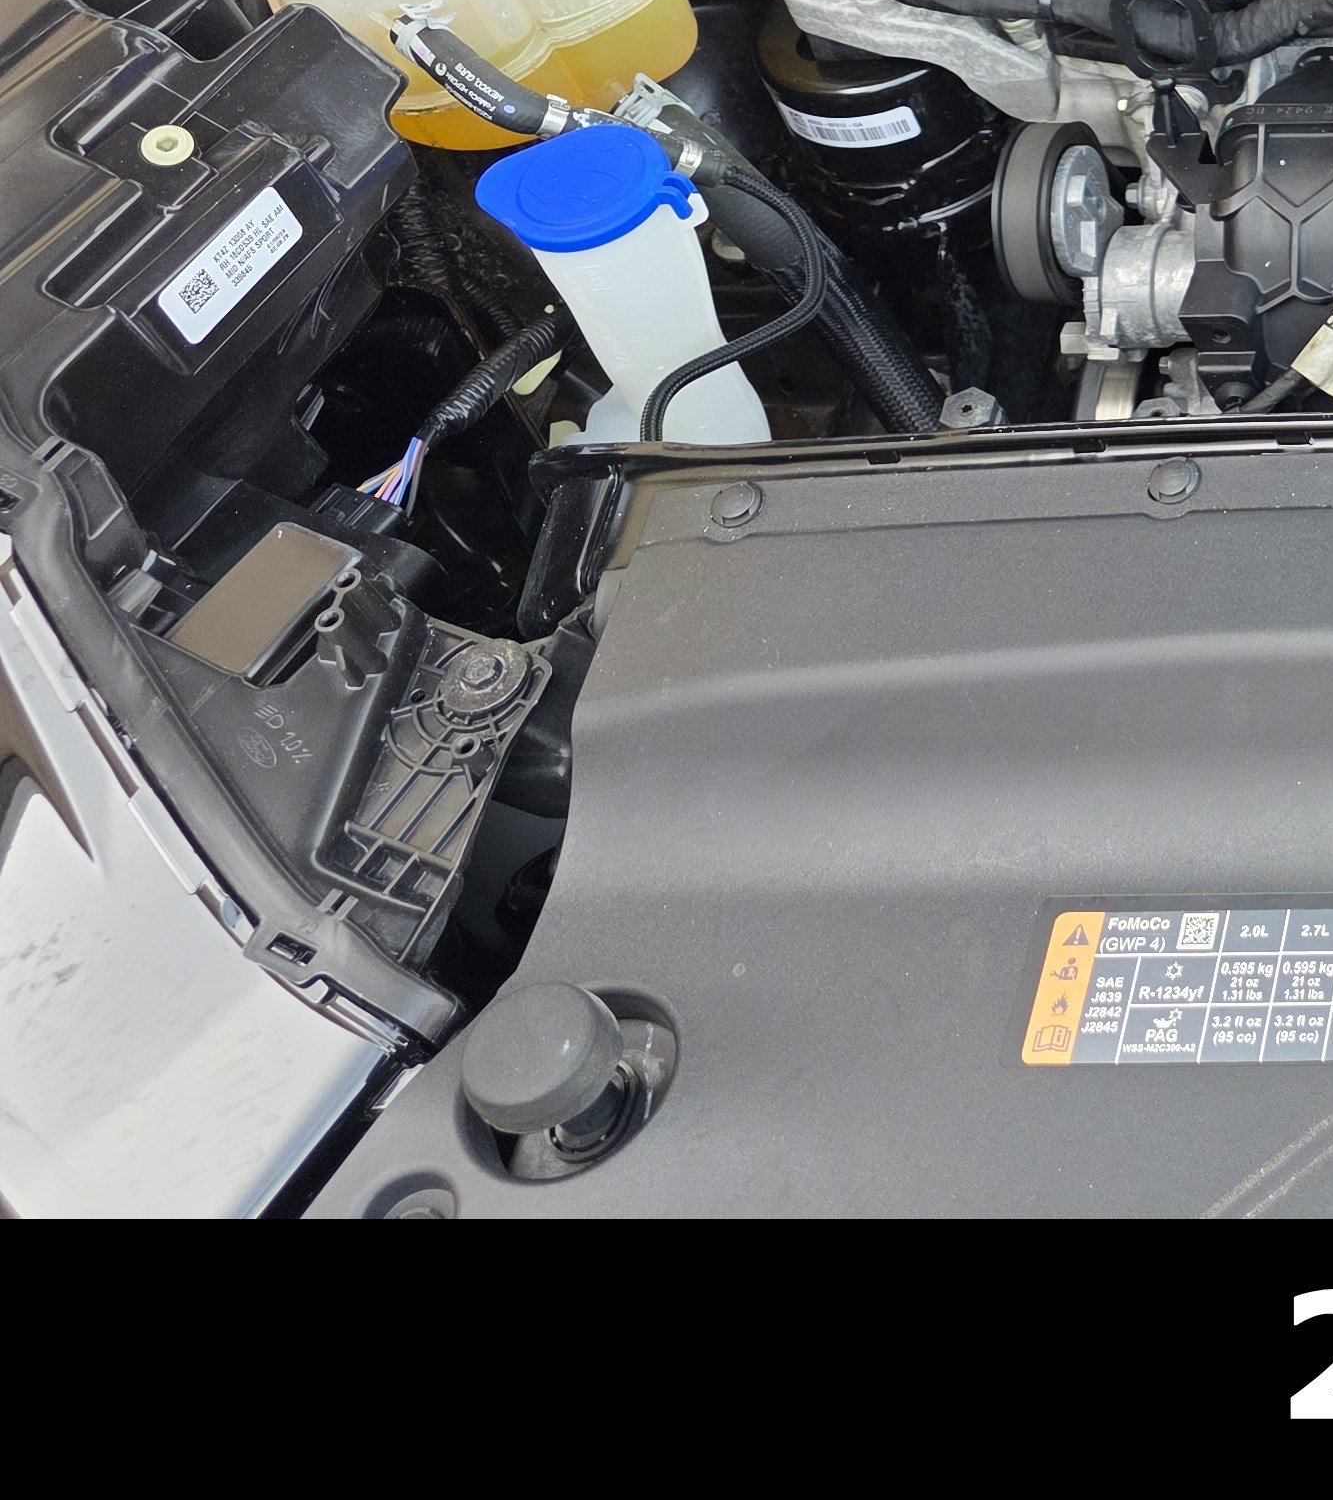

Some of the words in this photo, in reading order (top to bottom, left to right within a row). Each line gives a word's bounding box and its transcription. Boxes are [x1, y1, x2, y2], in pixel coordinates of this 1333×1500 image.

[261, 215, 275, 229] SAE
[256, 228, 276, 249] SPORT
[1107, 916, 1171, 931] FoMoCo
[1239, 924, 1269, 938] 2.0L
[1300, 924, 1330, 938] 2.7L
[1099, 936, 1147, 954] (GWP
[1148, 936, 1166, 953] 4)
[1220, 961, 1257, 975] 0.595
[1257, 961, 1274, 978] kg
[1282, 961, 1318, 975] 0.595
[1095, 976, 1125, 988] SAE
[1229, 976, 1244, 988] 21
[1246, 978, 1259, 988] oz
[1291, 976, 1307, 988] 21
[1308, 978, 1321, 988] oz
[1090, 992, 1122, 1004] J639
[1138, 985, 1204, 1002] R-1234yf
[1221, 989, 1244, 1001] 1.31
[1245, 988, 1263, 1001] lbs
[1283, 989, 1305, 1001] 1.31
[1307, 988, 1324, 1001] lbs
[1084, 1007, 1122, 1018] J2842
[1080, 1021, 1119, 1034] J2845
[1211, 1015, 1231, 1028] 3.2
[1233, 1015, 1245, 1028] fl
[1246, 1016, 1262, 1028] oz
[1273, 1015, 1293, 1028] 3.2
[1295, 1015, 1307, 1028] fl
[1309, 1016, 1324, 1028] oz
[1144, 1028, 1179, 1043] PAG
[1212, 1030, 1235, 1045] (95
[1236, 1030, 1257, 1045] cc)
[1275, 1030, 1298, 1045] (95
[1299, 1030, 1320, 1045] cc)
